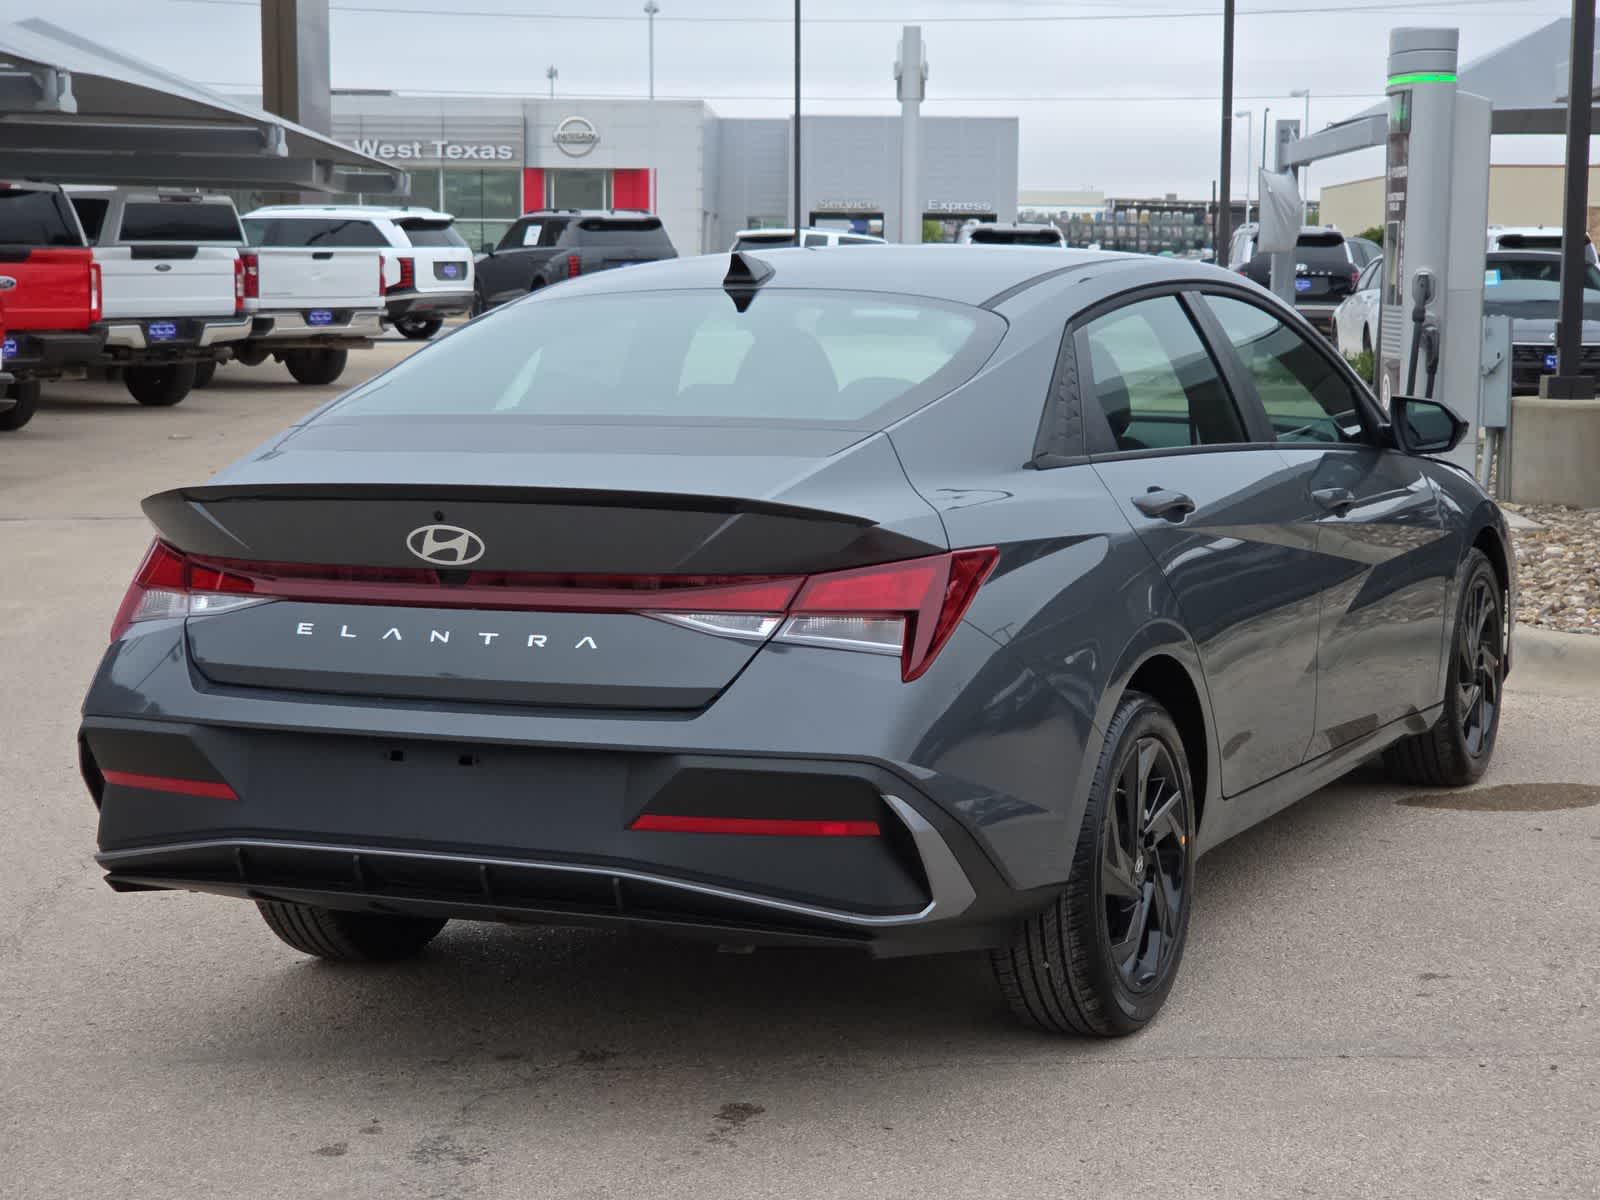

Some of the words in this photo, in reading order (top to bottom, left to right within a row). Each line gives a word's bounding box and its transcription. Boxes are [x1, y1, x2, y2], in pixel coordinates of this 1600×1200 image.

[353, 139, 422, 158] West
[431, 140, 513, 159] Texas
[927, 199, 992, 211] Express
[296, 622, 598, 649] ELANTRA
